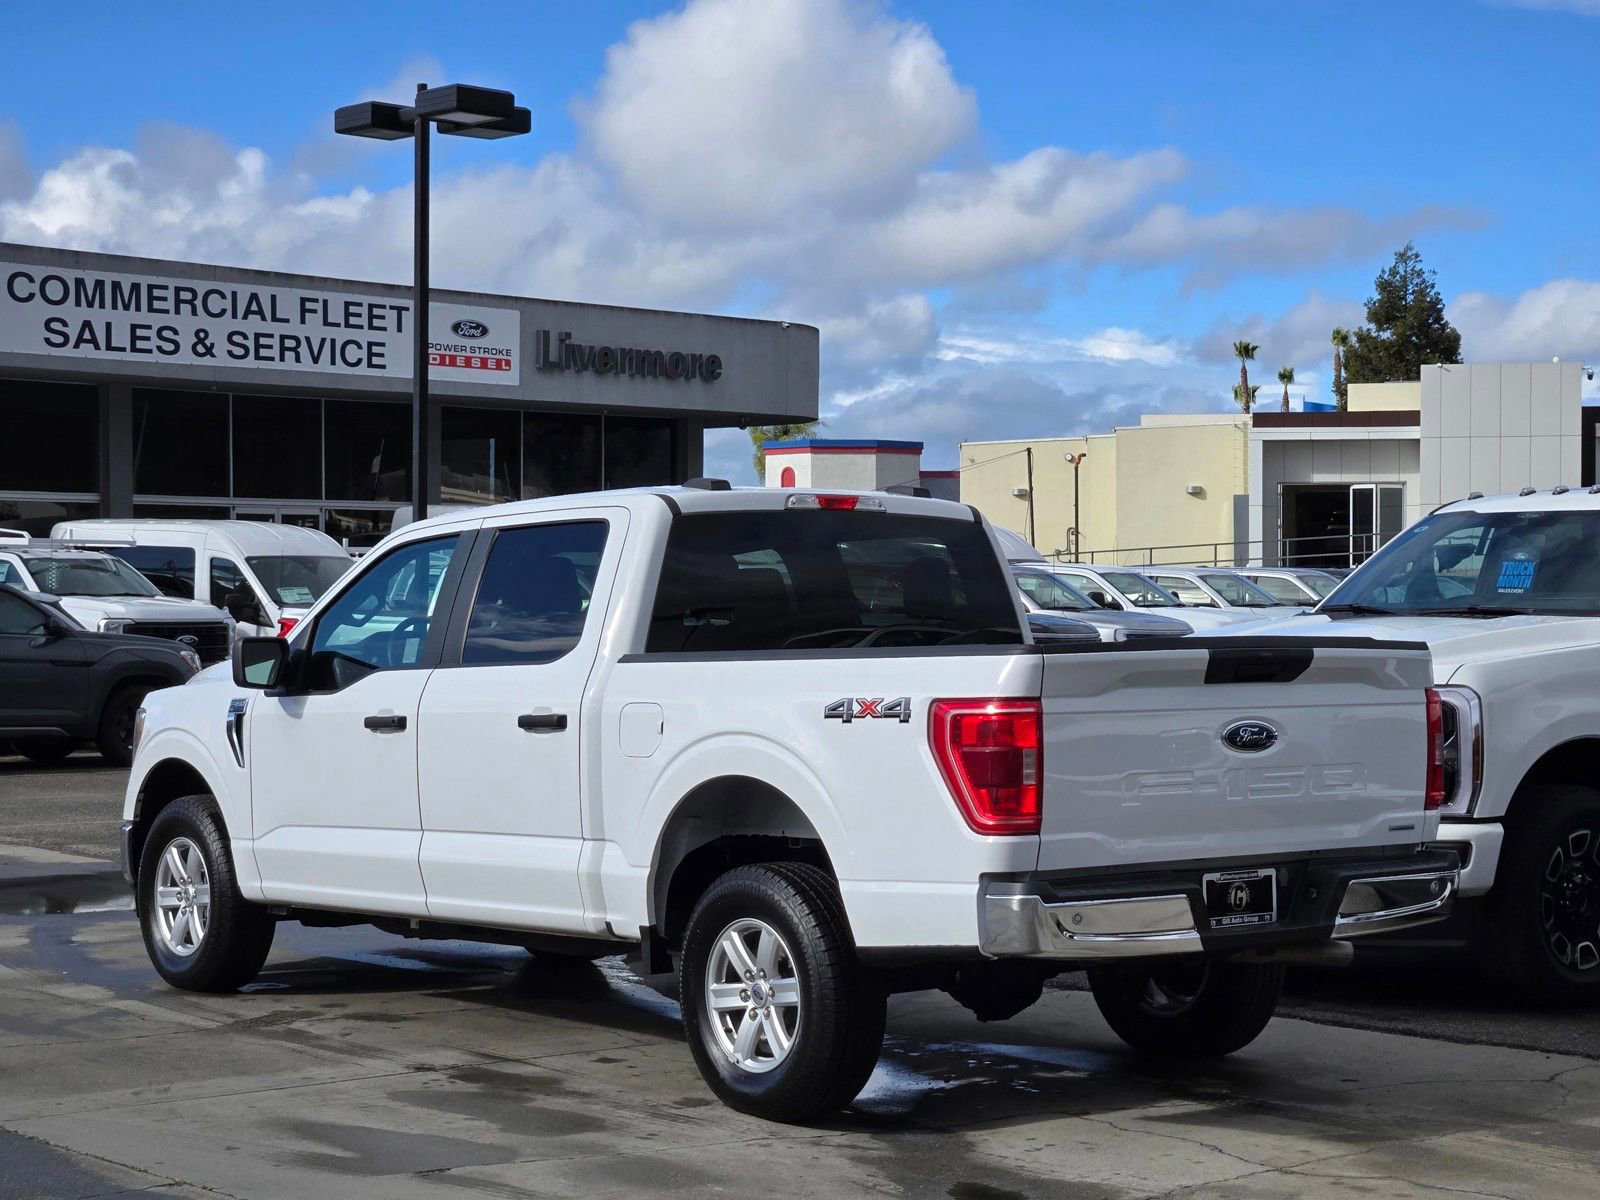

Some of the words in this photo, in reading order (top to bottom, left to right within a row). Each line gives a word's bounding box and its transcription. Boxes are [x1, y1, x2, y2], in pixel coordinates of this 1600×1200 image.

[6, 271, 290, 324] COMMERCIAL
[299, 296, 410, 333] FLEET
[458, 321, 482, 337] Ford
[43, 316, 181, 357] SALES
[190, 327, 217, 359] &
[226, 330, 387, 370] SERVICE
[428, 342, 468, 354] POWER
[469, 345, 512, 357] STROKE
[429, 354, 510, 370] DIESEL
[535, 329, 723, 383] Livermore
[1502, 561, 1537, 576] TRUCK
[1496, 575, 1533, 588] MONTH
[1236, 726, 1267, 746] Ford
